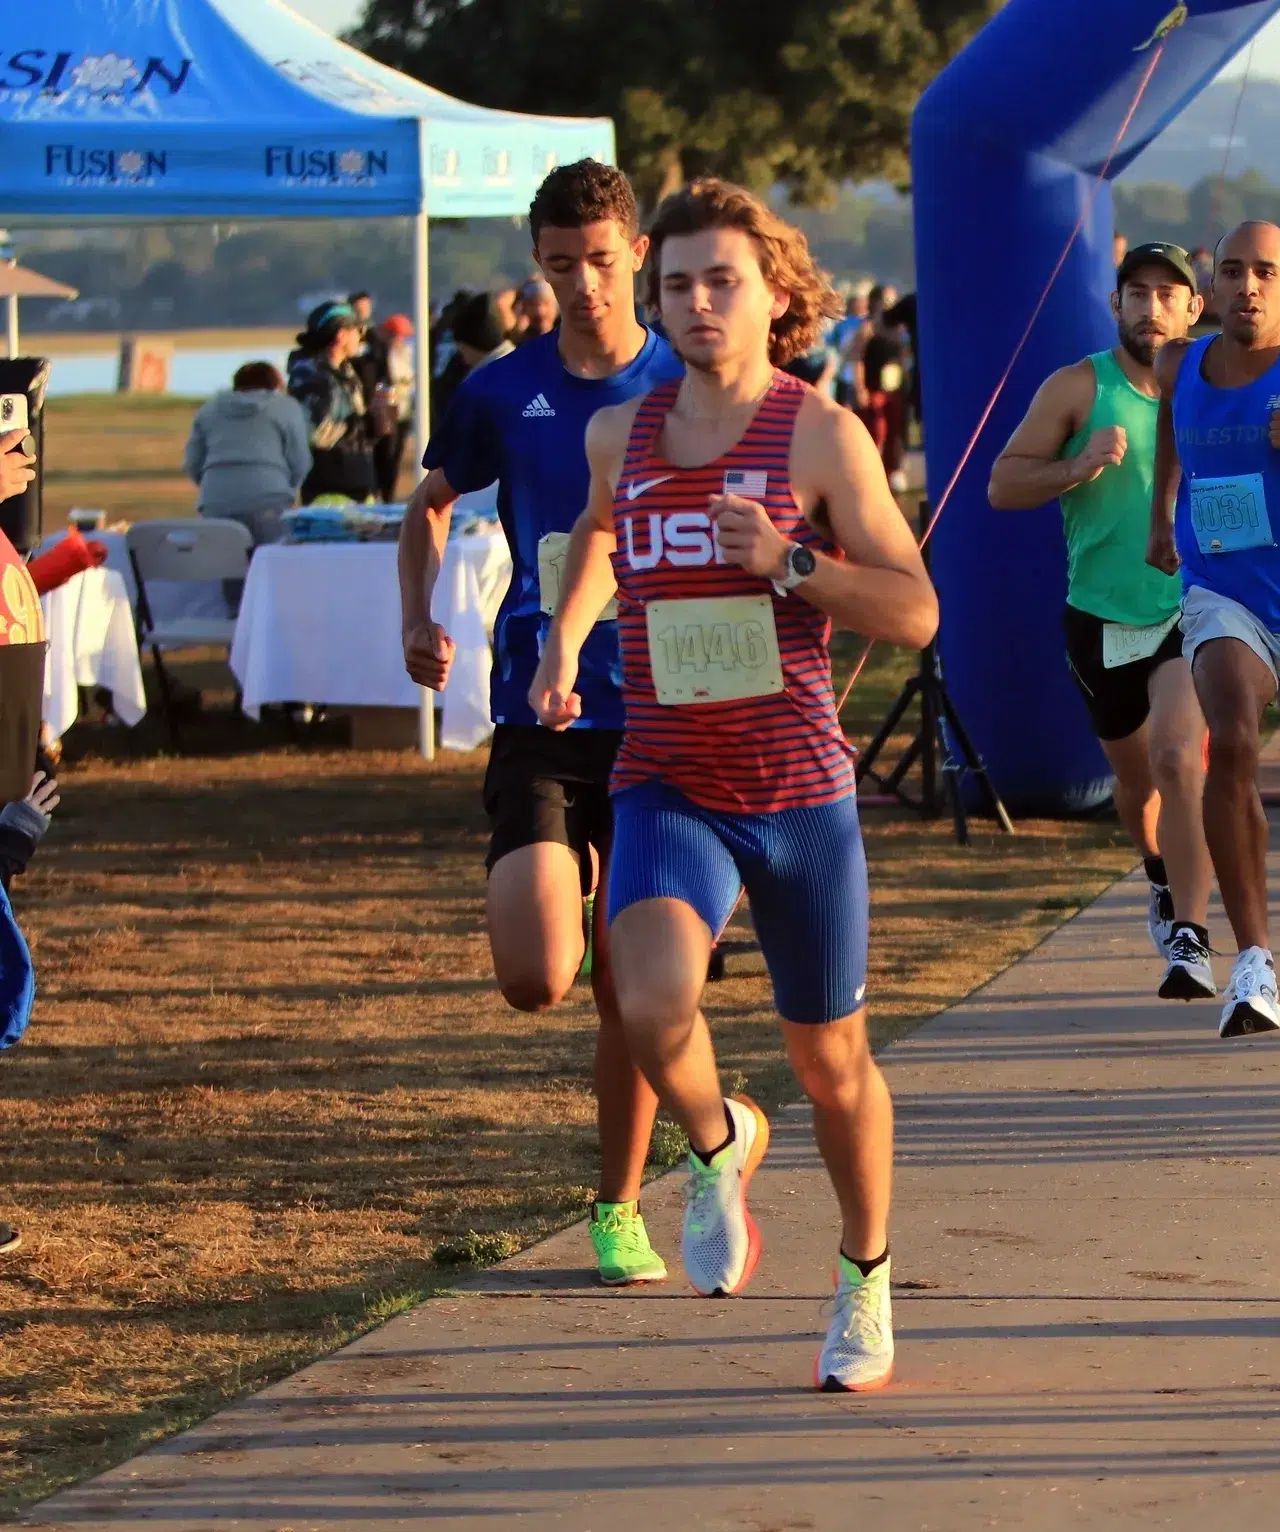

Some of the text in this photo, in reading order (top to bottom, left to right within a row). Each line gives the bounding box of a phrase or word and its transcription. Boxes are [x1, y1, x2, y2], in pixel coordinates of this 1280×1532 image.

[45, 144, 168, 177] FUSION
[265, 145, 388, 178] FUSION
[522, 407, 556, 417] adidas
[1178, 424, 1269, 446] MILESTON
[1191, 492, 1260, 532] 1031
[623, 511, 725, 571] US
[656, 620, 769, 674] 1446
